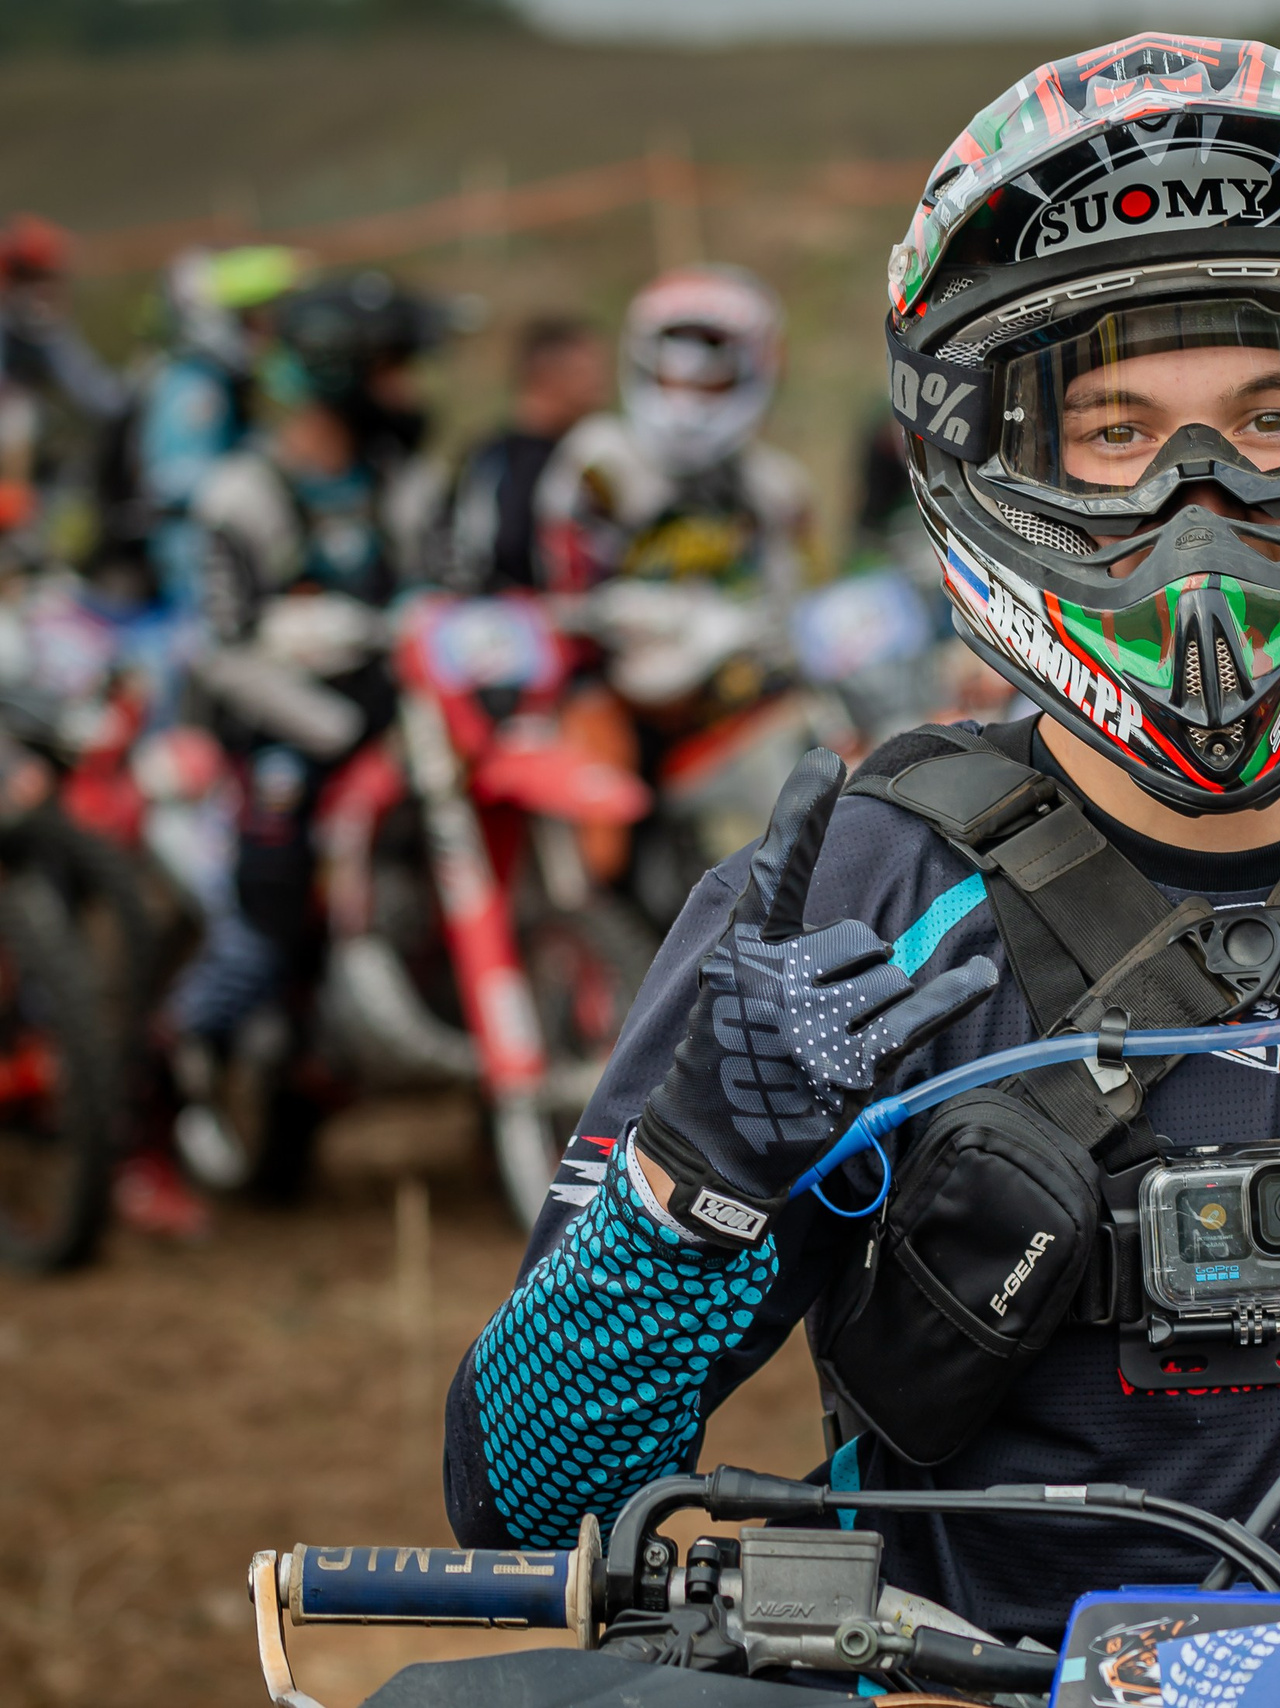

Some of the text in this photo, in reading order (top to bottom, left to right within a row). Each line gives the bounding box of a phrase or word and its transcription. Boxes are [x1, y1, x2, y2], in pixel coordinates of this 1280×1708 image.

[1040, 177, 1272, 247] SUOMY
[701, 1199, 755, 1231] 100%
[990, 1231, 1055, 1317] E-GEAR
[1195, 1264, 1239, 1275] GoPro
